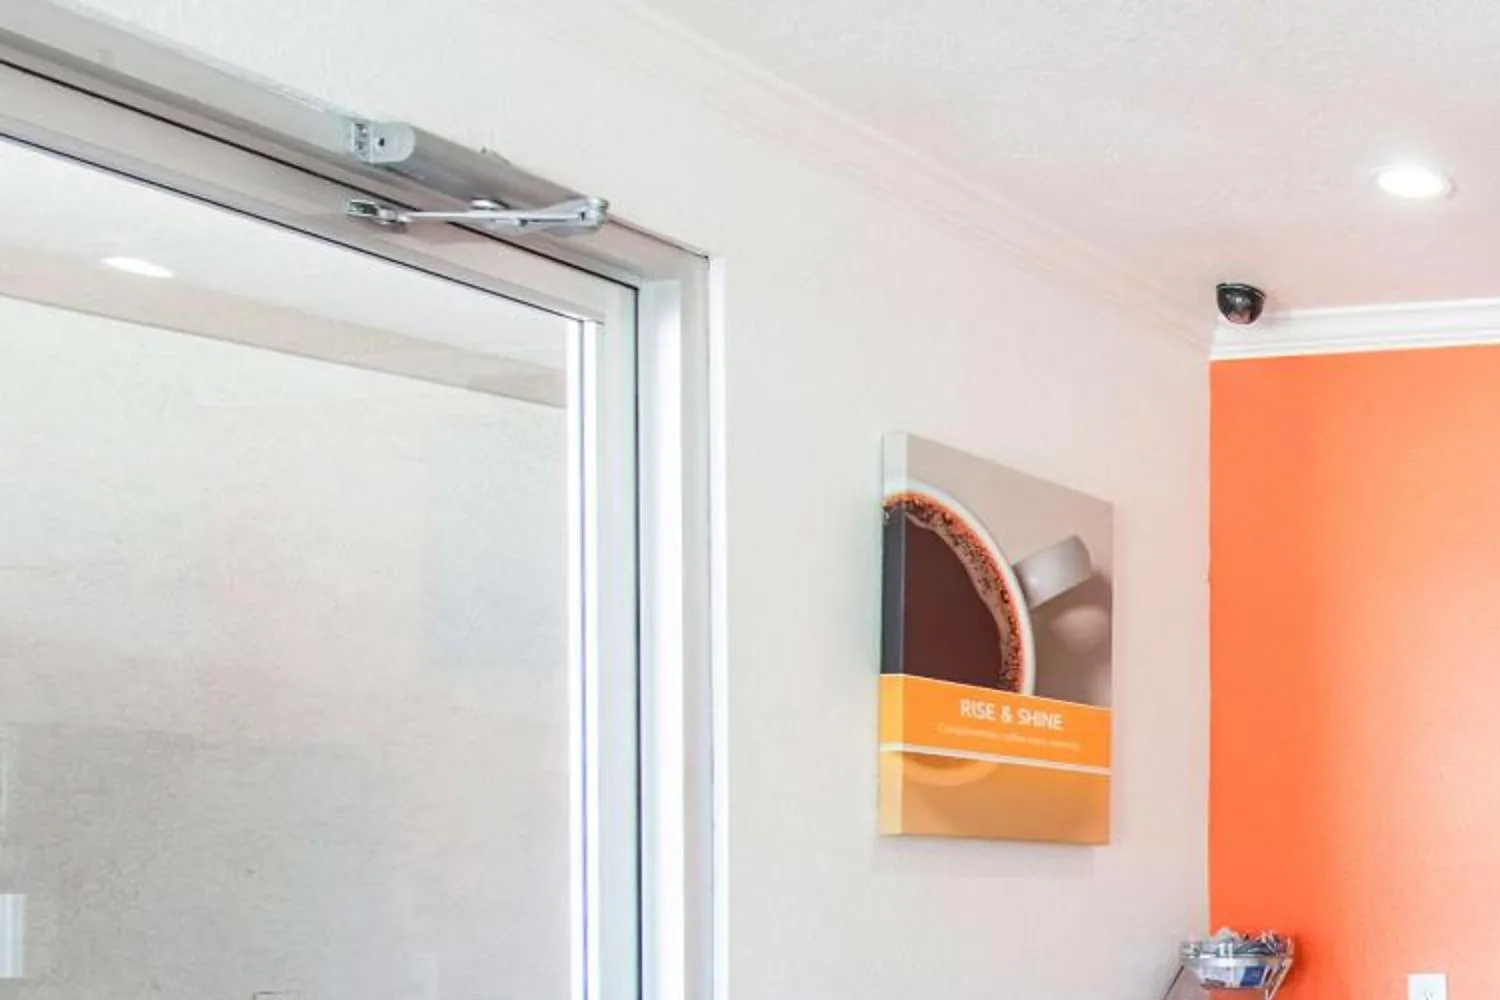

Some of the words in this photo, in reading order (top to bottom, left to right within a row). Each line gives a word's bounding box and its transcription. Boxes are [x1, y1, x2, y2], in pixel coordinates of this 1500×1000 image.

[960, 699, 996, 721] RISE
[1001, 705, 1012, 723] &
[1017, 708, 1064, 731] SHINE
